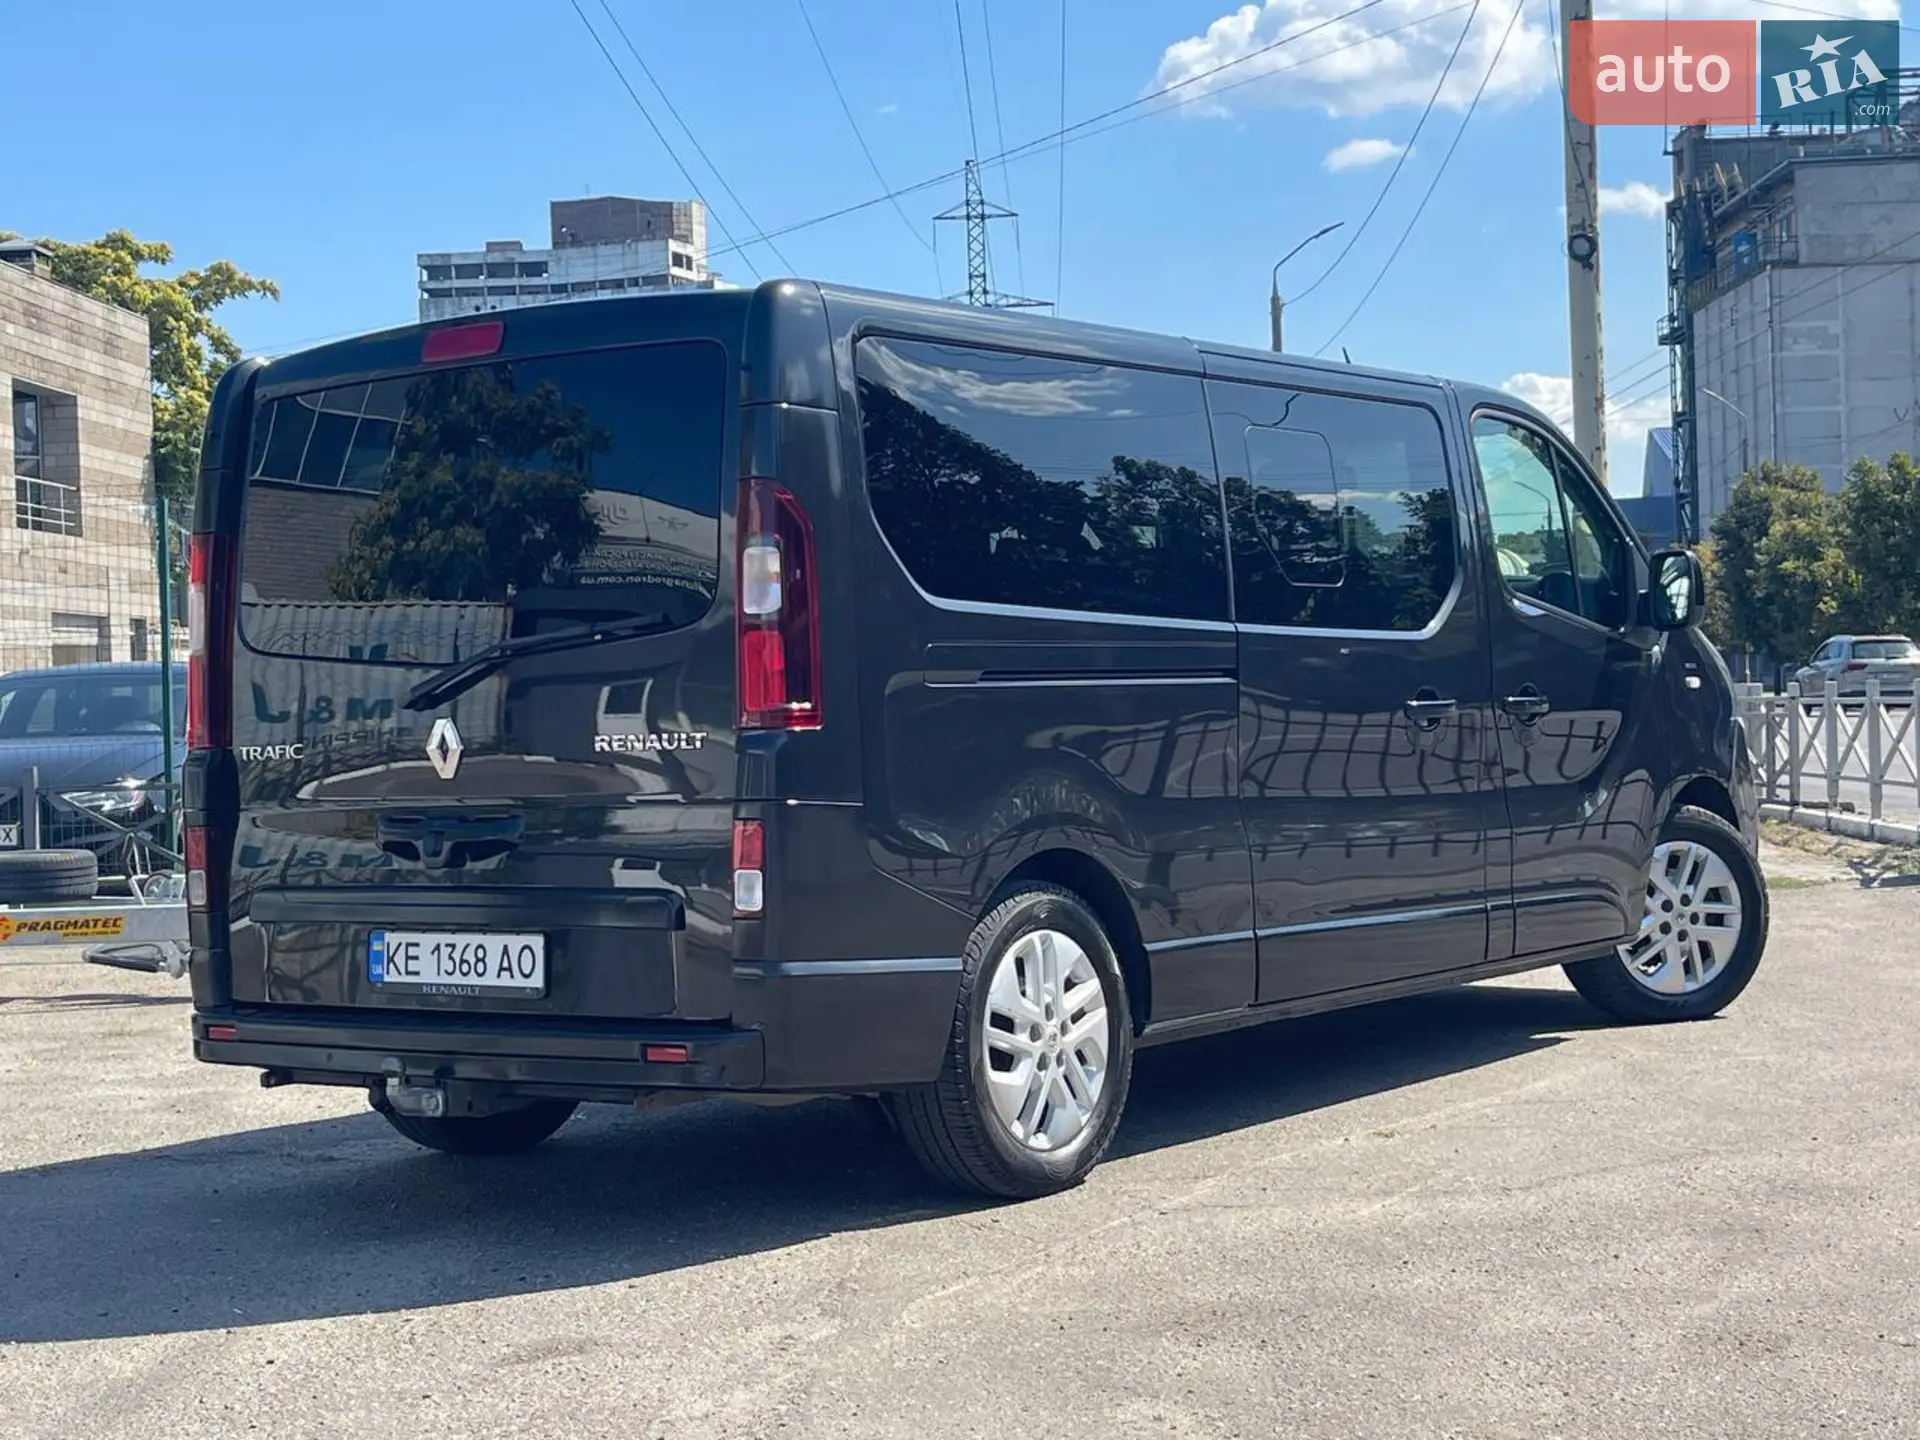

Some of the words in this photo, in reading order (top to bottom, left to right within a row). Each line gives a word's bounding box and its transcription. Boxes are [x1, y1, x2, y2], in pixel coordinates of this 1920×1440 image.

[594, 732, 707, 752] RENAULT
[239, 743, 304, 761] TRAFIC
[16, 917, 123, 932] PRAGMATEC
[386, 942, 420, 976] KE
[431, 943, 487, 977] 1368
[496, 944, 536, 979] AO
[422, 984, 480, 996] RENAULT
